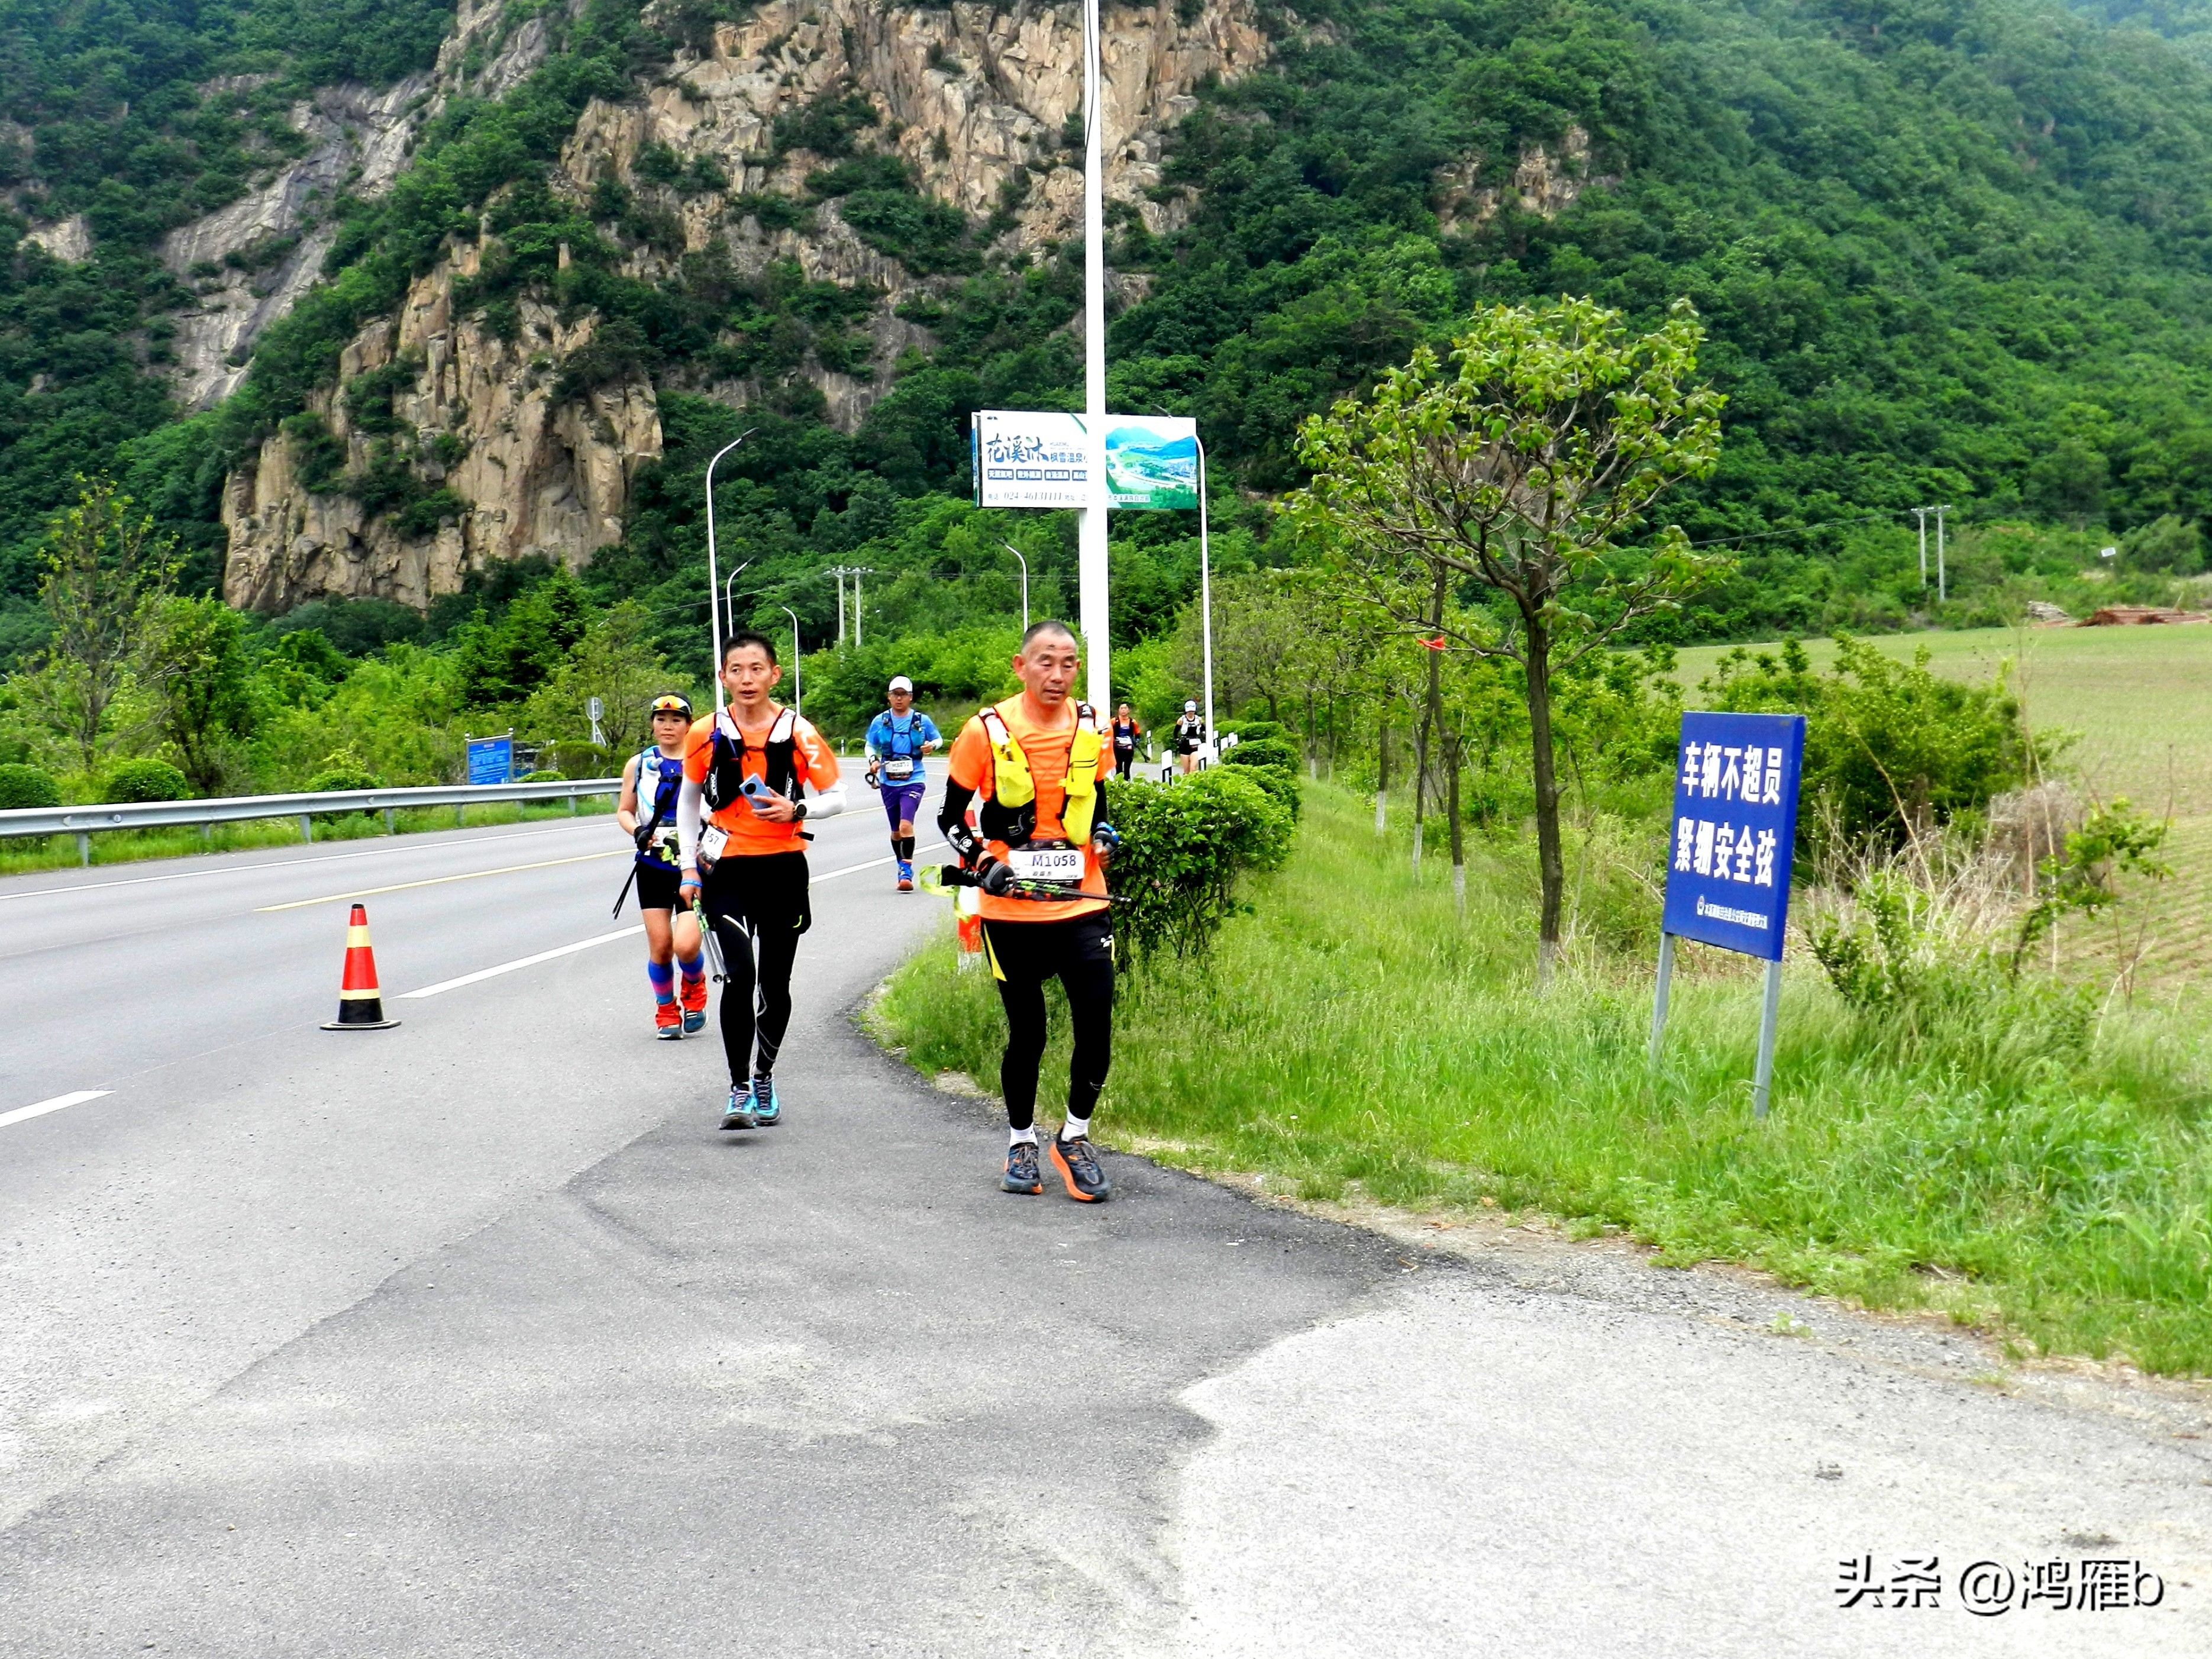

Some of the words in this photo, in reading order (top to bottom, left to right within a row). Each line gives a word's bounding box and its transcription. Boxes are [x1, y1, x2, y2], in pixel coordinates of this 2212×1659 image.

[986, 432, 1049, 463] 花溪沐
[1682, 741, 1782, 805] 车辆不超员
[1032, 855, 1076, 867] M1058
[1674, 816, 1776, 887] 紧绷安全弦
